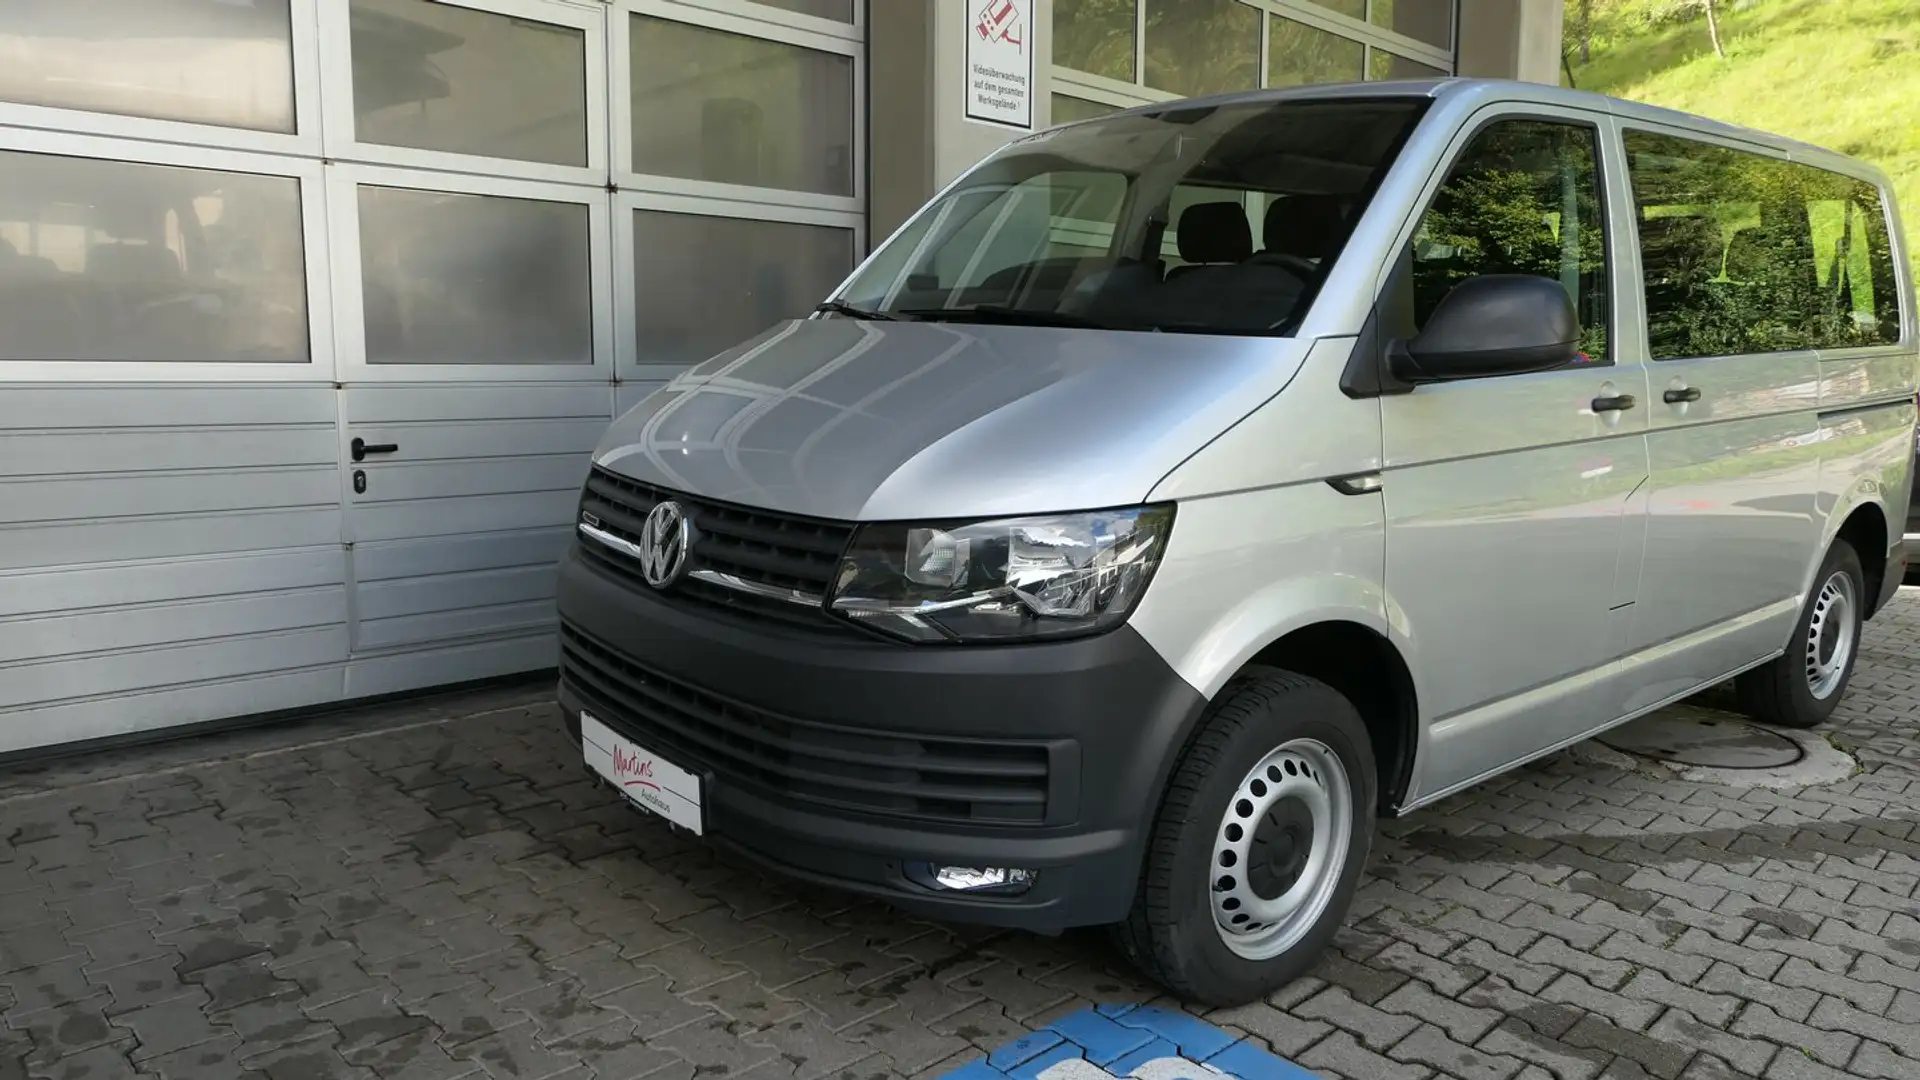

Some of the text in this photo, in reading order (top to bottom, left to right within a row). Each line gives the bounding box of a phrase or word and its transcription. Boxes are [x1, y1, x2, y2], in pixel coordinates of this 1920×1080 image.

[973, 64, 1025, 86] Videoüberwachung
[974, 79, 984, 89] auf
[998, 84, 1024, 97] gesamten
[613, 743, 653, 778] Martins
[641, 788, 671, 813] Autohaus
